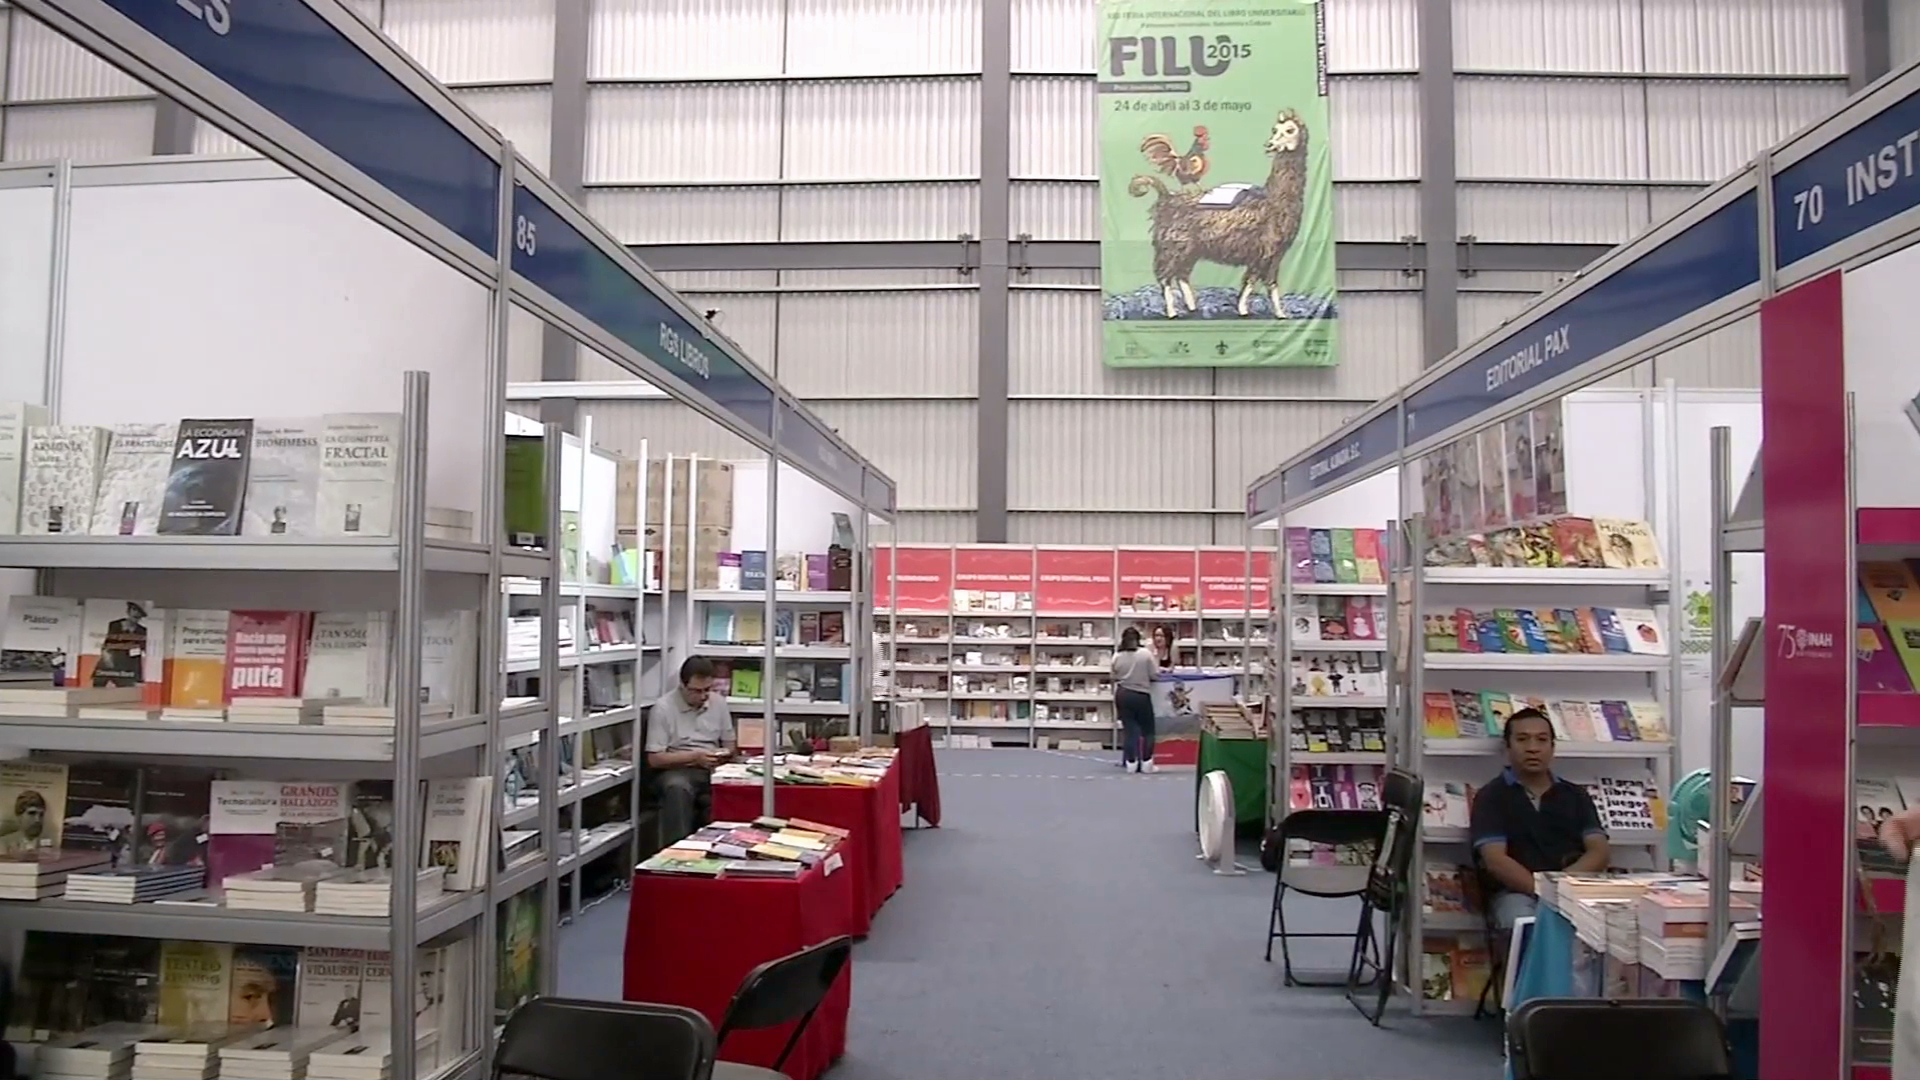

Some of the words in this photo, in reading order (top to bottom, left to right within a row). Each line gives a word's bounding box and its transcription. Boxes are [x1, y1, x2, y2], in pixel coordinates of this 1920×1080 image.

[1109, 35, 1232, 77] FILU
[1206, 43, 1251, 59] 2015
[1114, 100, 1130, 112] 24
[1132, 100, 1148, 112] de
[1150, 100, 1176, 112] abril
[1178, 100, 1190, 112] al
[1191, 100, 1201, 112] 3
[1203, 100, 1218, 112] de
[1220, 101, 1252, 113] mayo
[1794, 184, 1824, 231] 70
[516, 215, 537, 257] 85
[1486, 342, 1543, 392] EDITORIAL
[1544, 323, 1571, 362] PAX
[177, 438, 242, 460] AZUL
[325, 446, 389, 459] FRACTAL
[1777, 624, 1797, 660] 75
[1808, 632, 1833, 648] INAH
[232, 665, 284, 690] puta
[280, 785, 340, 797] GRANDES
[1603, 788, 1638, 797] libro
[1615, 779, 1645, 790] gran
[1609, 810, 1638, 818] para
[1611, 819, 1654, 829] mente
